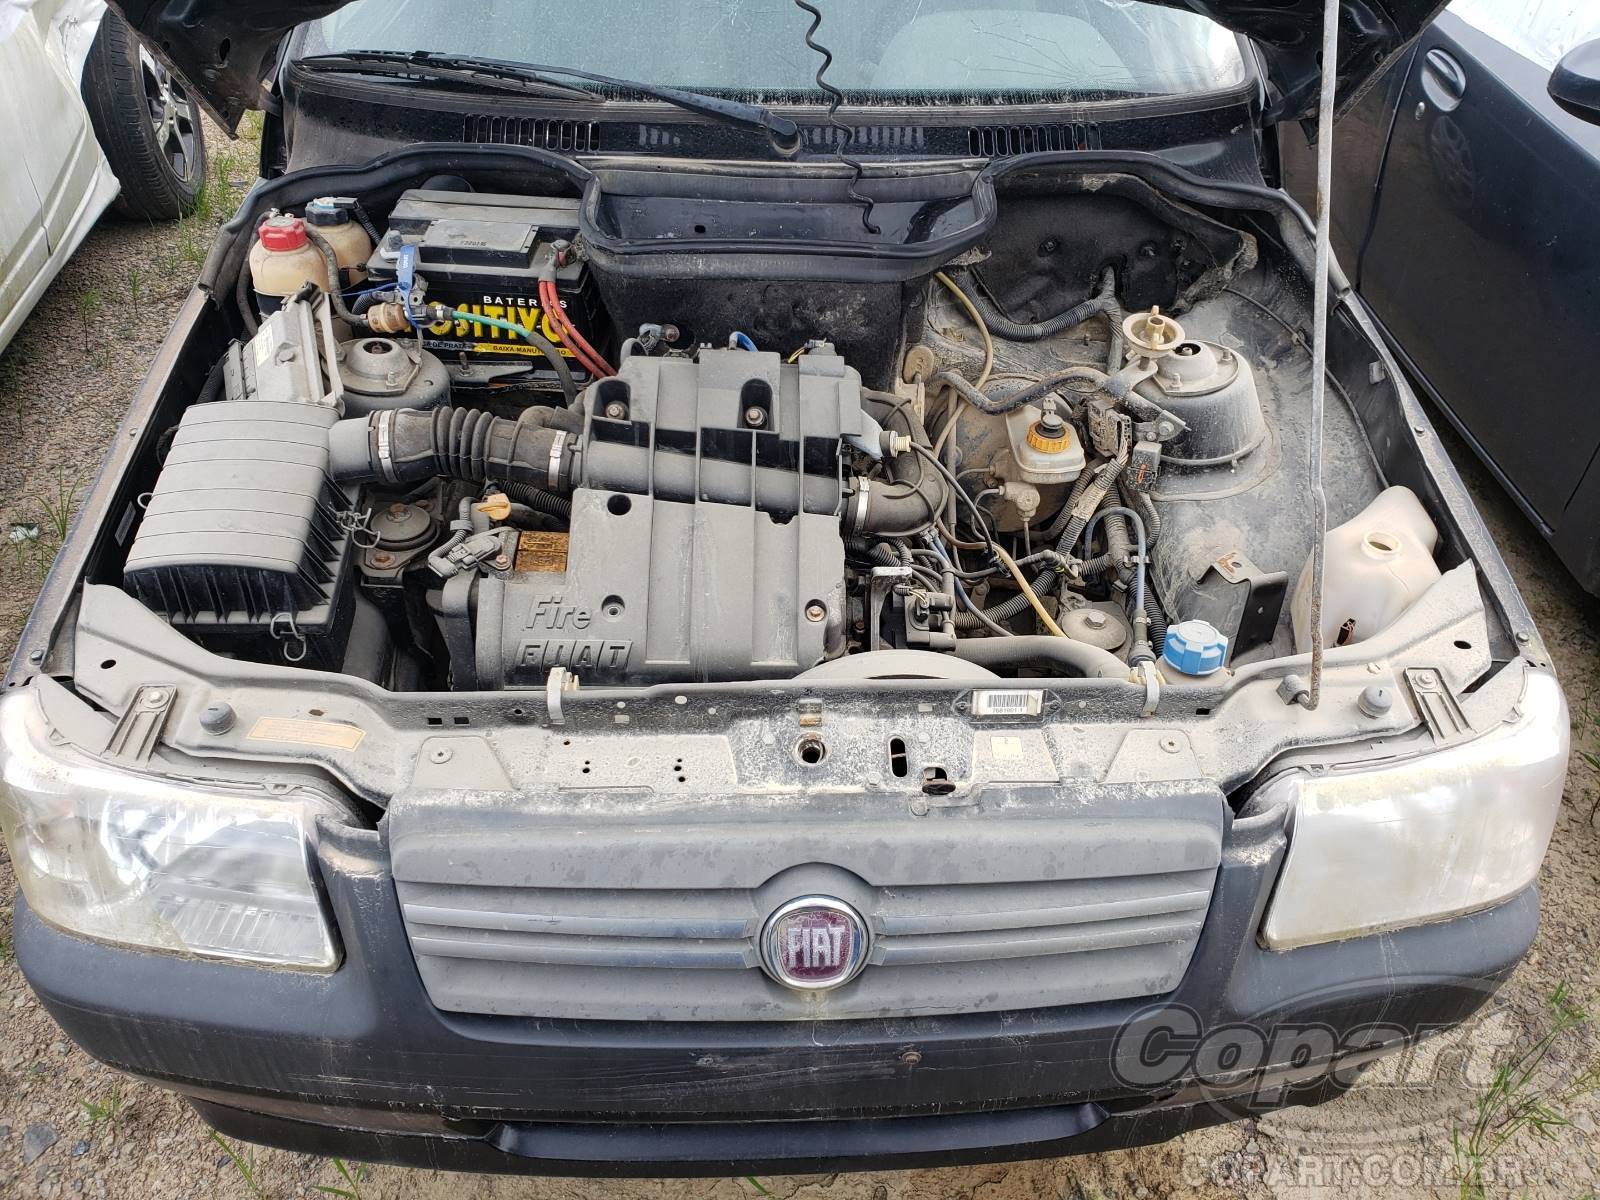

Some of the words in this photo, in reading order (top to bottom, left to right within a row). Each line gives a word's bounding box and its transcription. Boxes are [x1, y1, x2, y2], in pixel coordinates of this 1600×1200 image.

[483, 295, 568, 309] BATERS
[404, 301, 569, 343] OSITIVO
[525, 595, 593, 629] Fire
[519, 643, 628, 669] FIAT
[787, 924, 846, 968] FIAT
